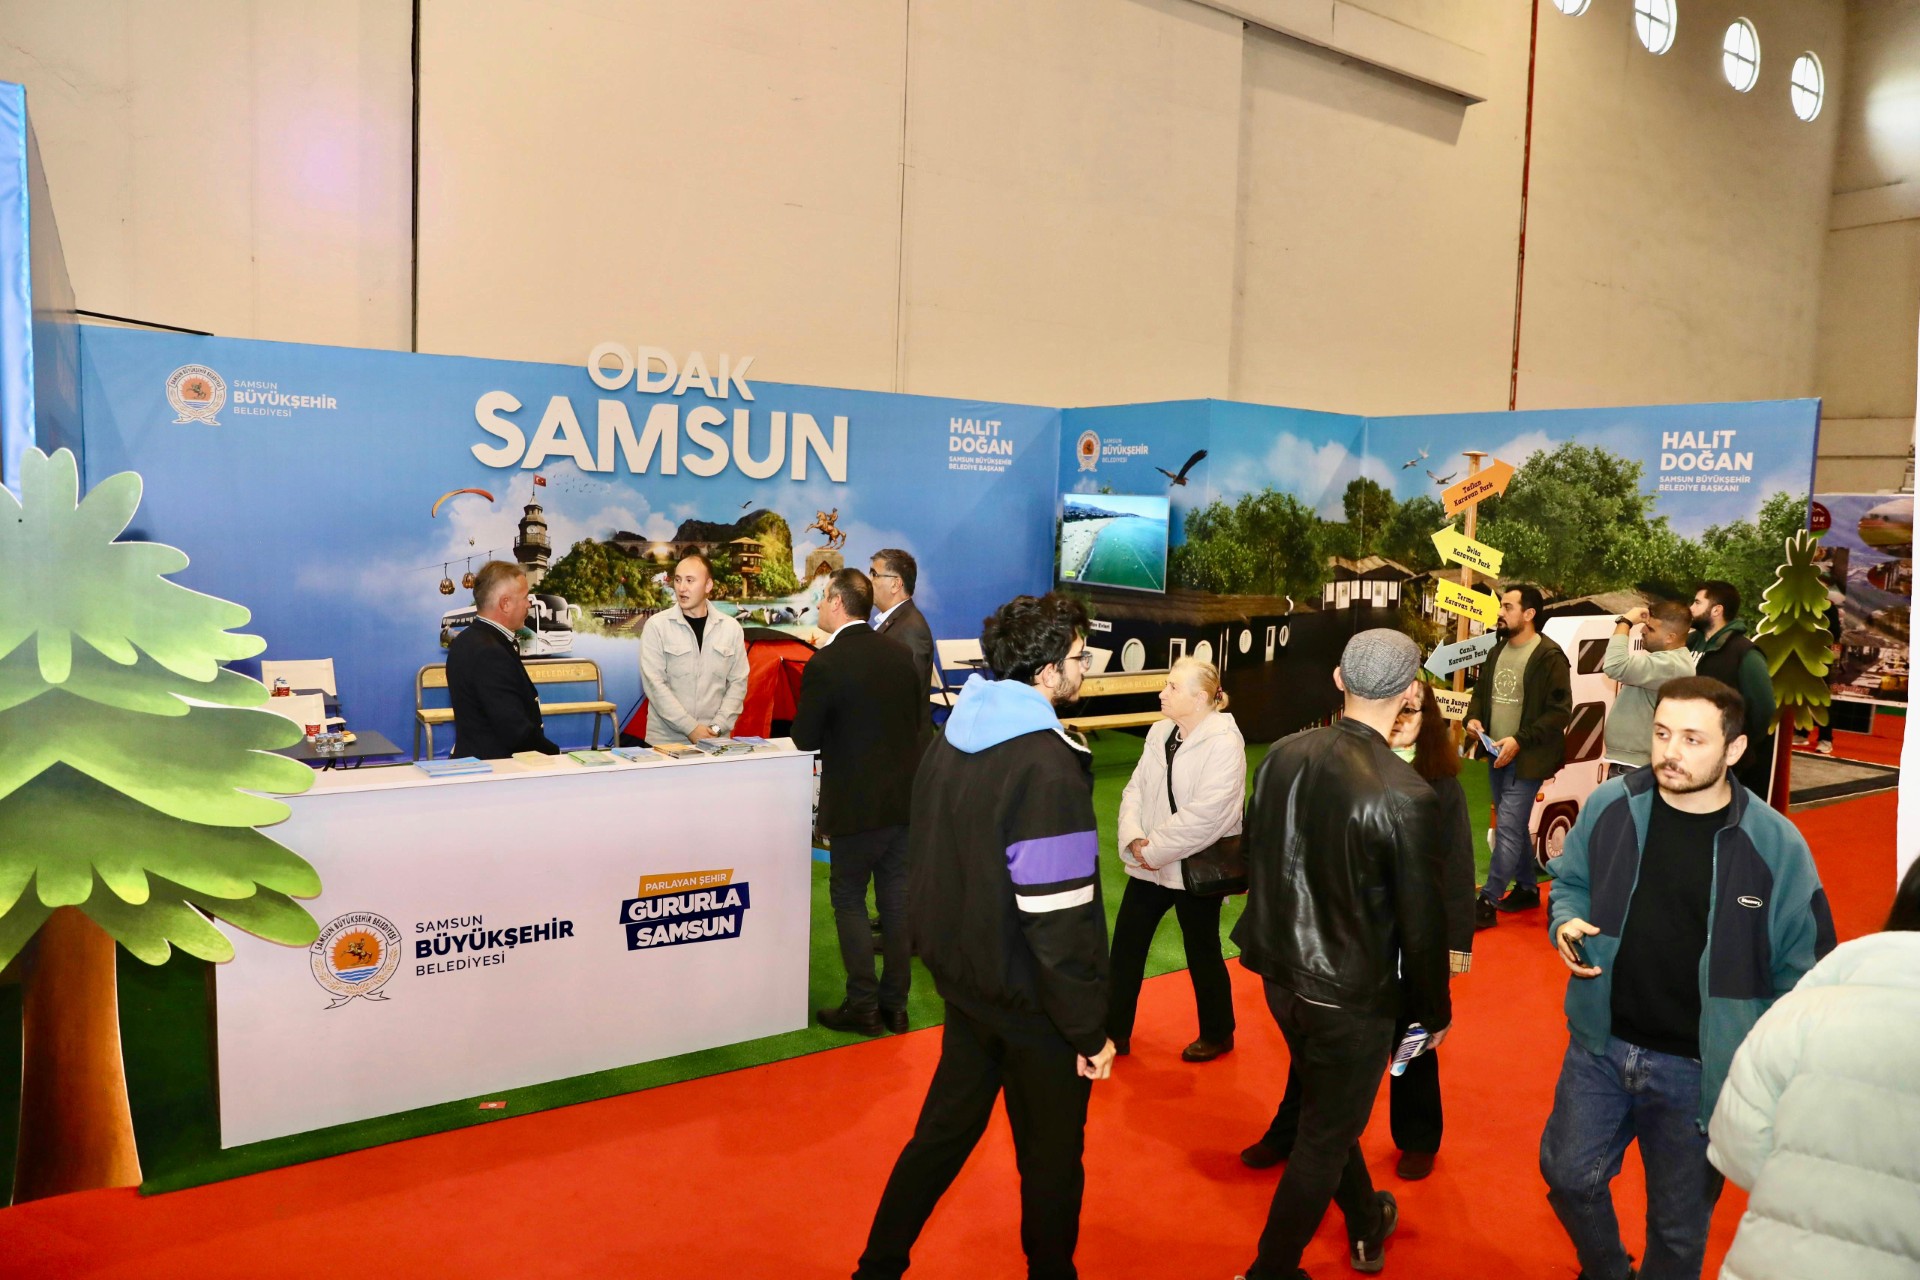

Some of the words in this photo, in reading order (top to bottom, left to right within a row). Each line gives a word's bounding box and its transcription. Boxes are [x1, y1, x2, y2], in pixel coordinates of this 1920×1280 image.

[587, 342, 755, 400] ODAK
[233, 379, 278, 390] SAMSUN
[233, 389, 337, 410] BÜYÜKŞEHİR
[233, 406, 292, 418] BELEDİYESİ
[470, 390, 849, 482] SAMSUN
[949, 435, 1013, 455] DOĞAN
[1102, 443, 1149, 456] BÜYÜKŞEHİR
[1660, 449, 1754, 471] DOĞAN
[1659, 475, 1694, 483] SAMSUN
[1696, 475, 1751, 485] BÜYÜKŞEHİR
[1659, 483, 1699, 492] BELEDİYE
[1701, 484, 1739, 493] BAŞKANI
[1454, 490, 1479, 507] Karavan
[1480, 482, 1494, 493] Park
[1453, 547, 1477, 563] Karavan
[1478, 558, 1491, 569] Park
[1445, 596, 1468, 610] Karavan
[1470, 605, 1483, 616] Park
[1457, 592, 1474, 604] Terme
[1448, 654, 1473, 666] Karavan
[1474, 648, 1488, 658] Park
[645, 877, 697, 892] PARLAYAN
[699, 873, 727, 886] ŞEHİR
[628, 888, 742, 921] GURURLA
[415, 915, 483, 934] SAMSUN
[636, 914, 735, 947] SAMSUN
[315, 927, 335, 950] SAMSUN
[415, 917, 575, 959] BÜYÜKŞEHİR
[415, 951, 506, 977] BELEDİYESİ
